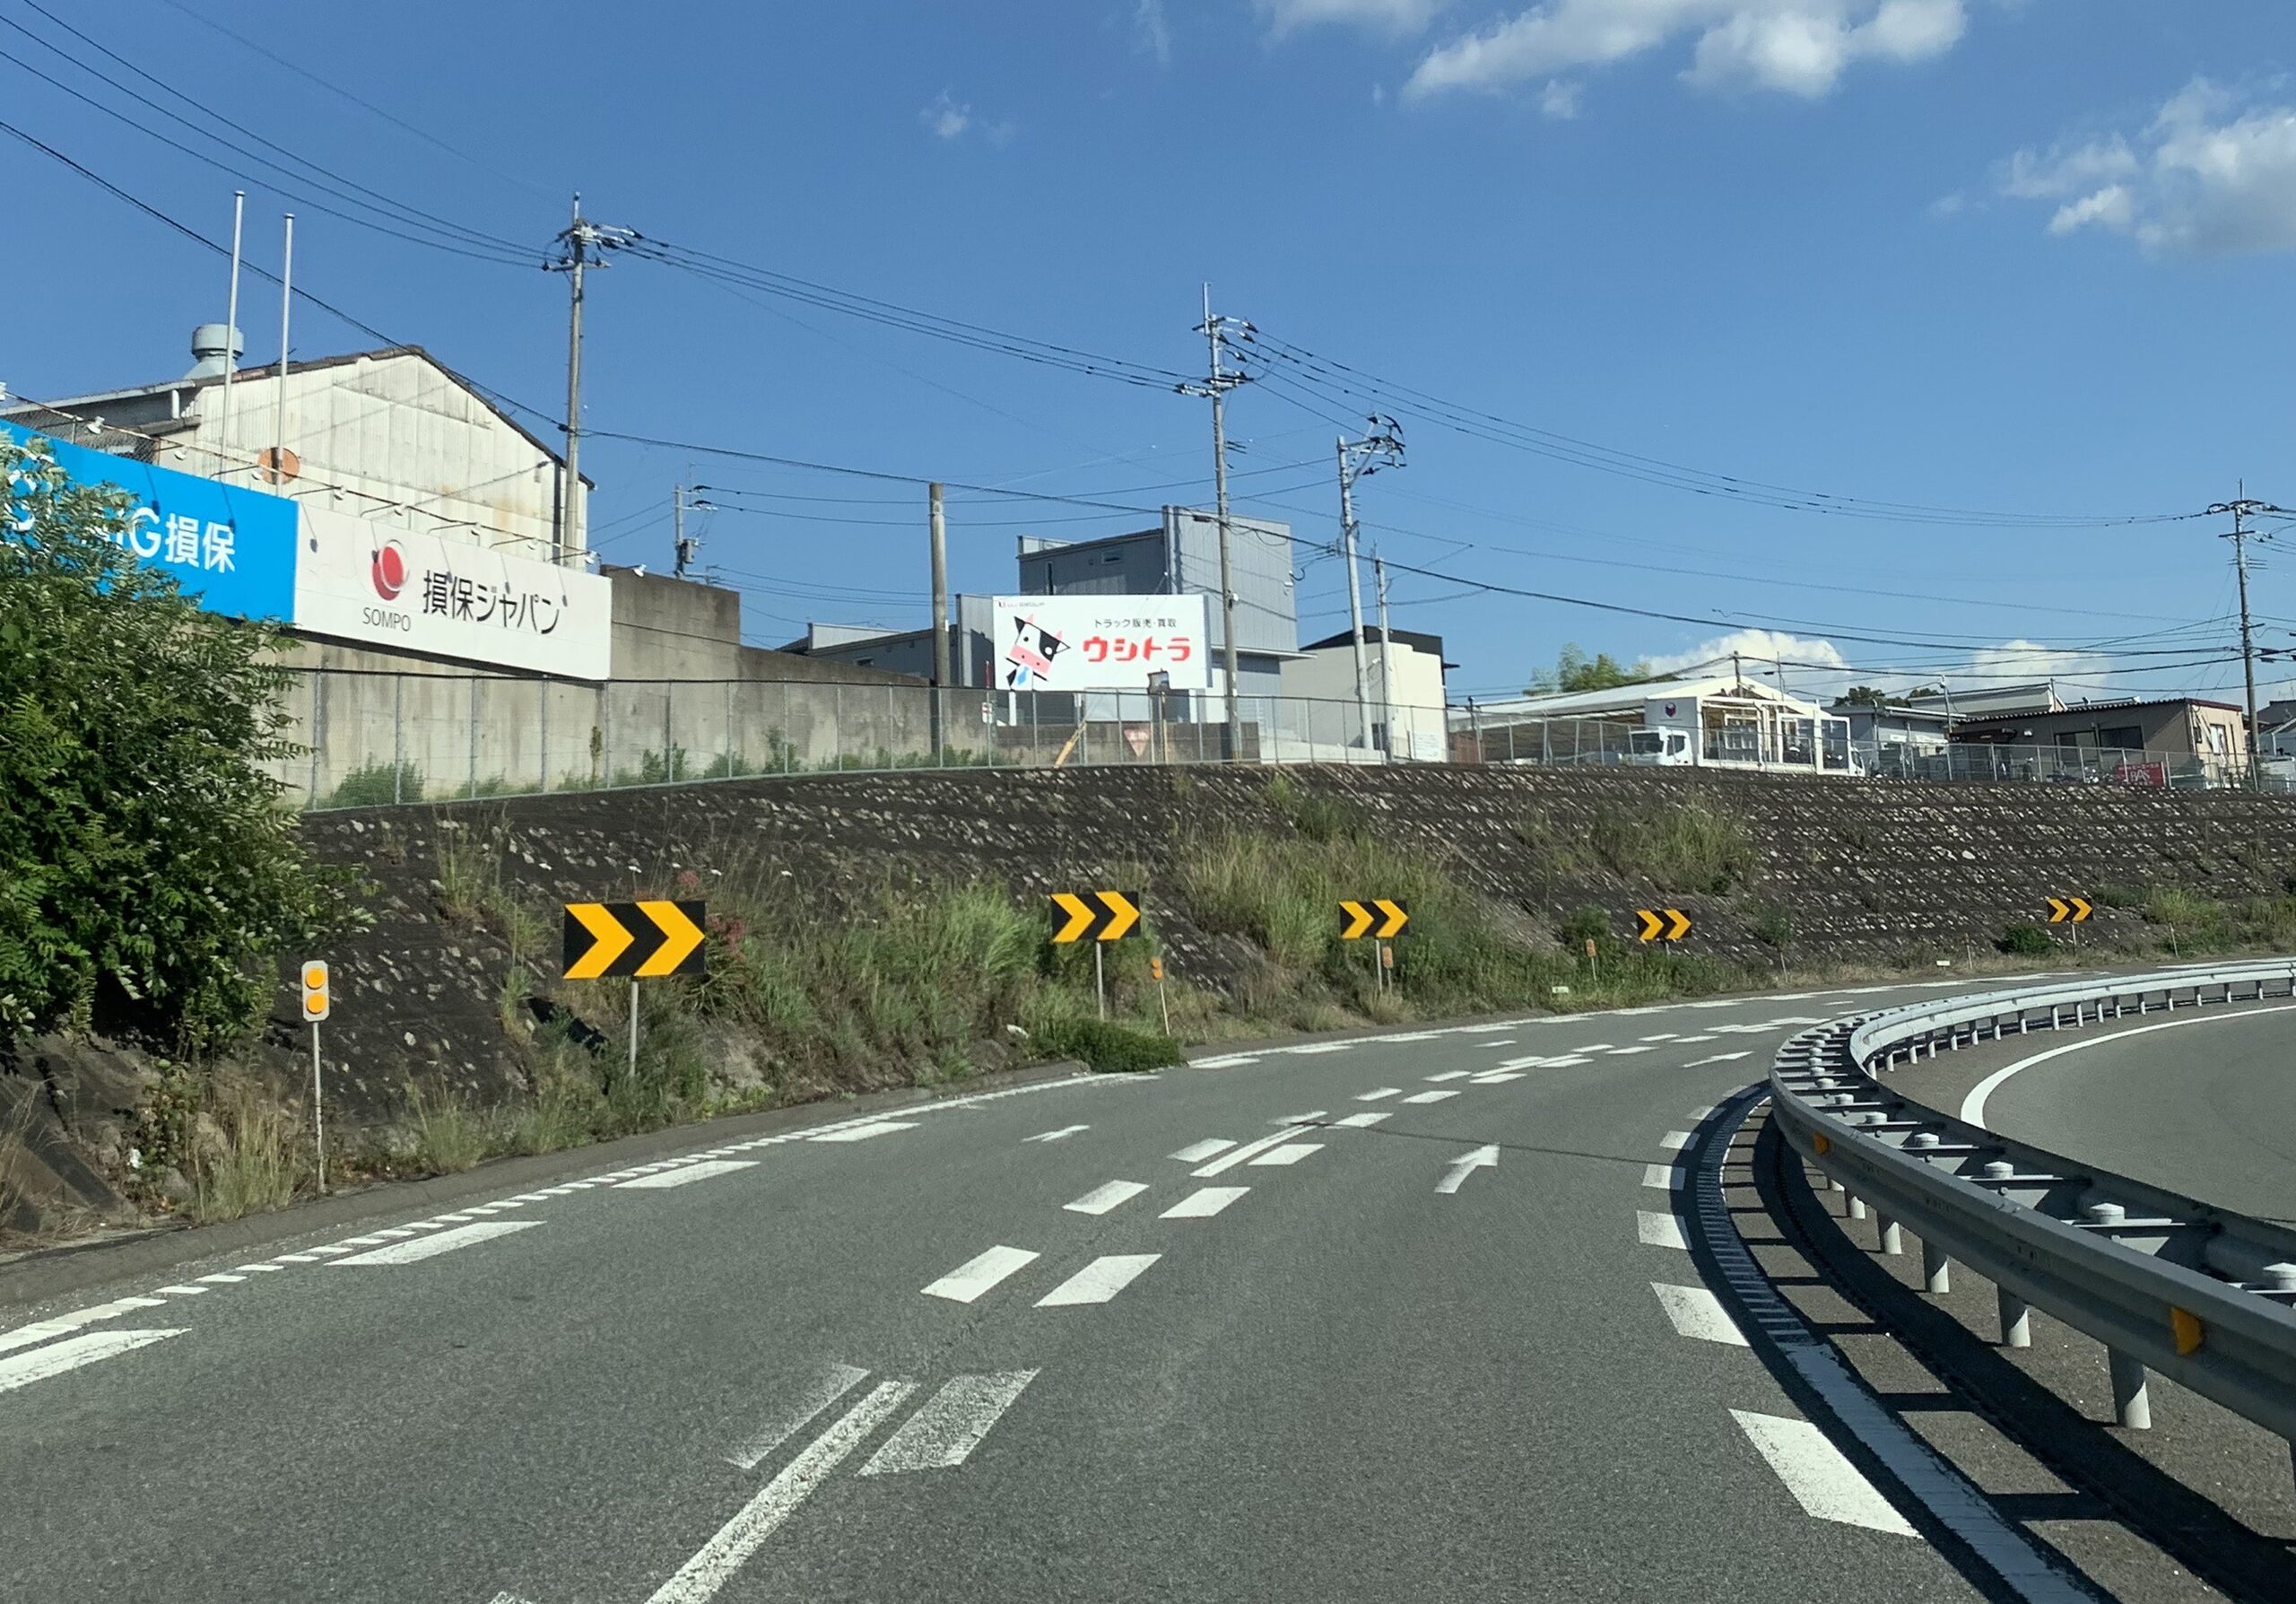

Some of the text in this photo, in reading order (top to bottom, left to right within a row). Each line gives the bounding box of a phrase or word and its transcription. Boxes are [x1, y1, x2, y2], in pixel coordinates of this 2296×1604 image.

[422, 569, 560, 634] 損保ジャパン
[362, 607, 411, 632] SOMPO
[1083, 635, 1191, 662] ウシトラ
